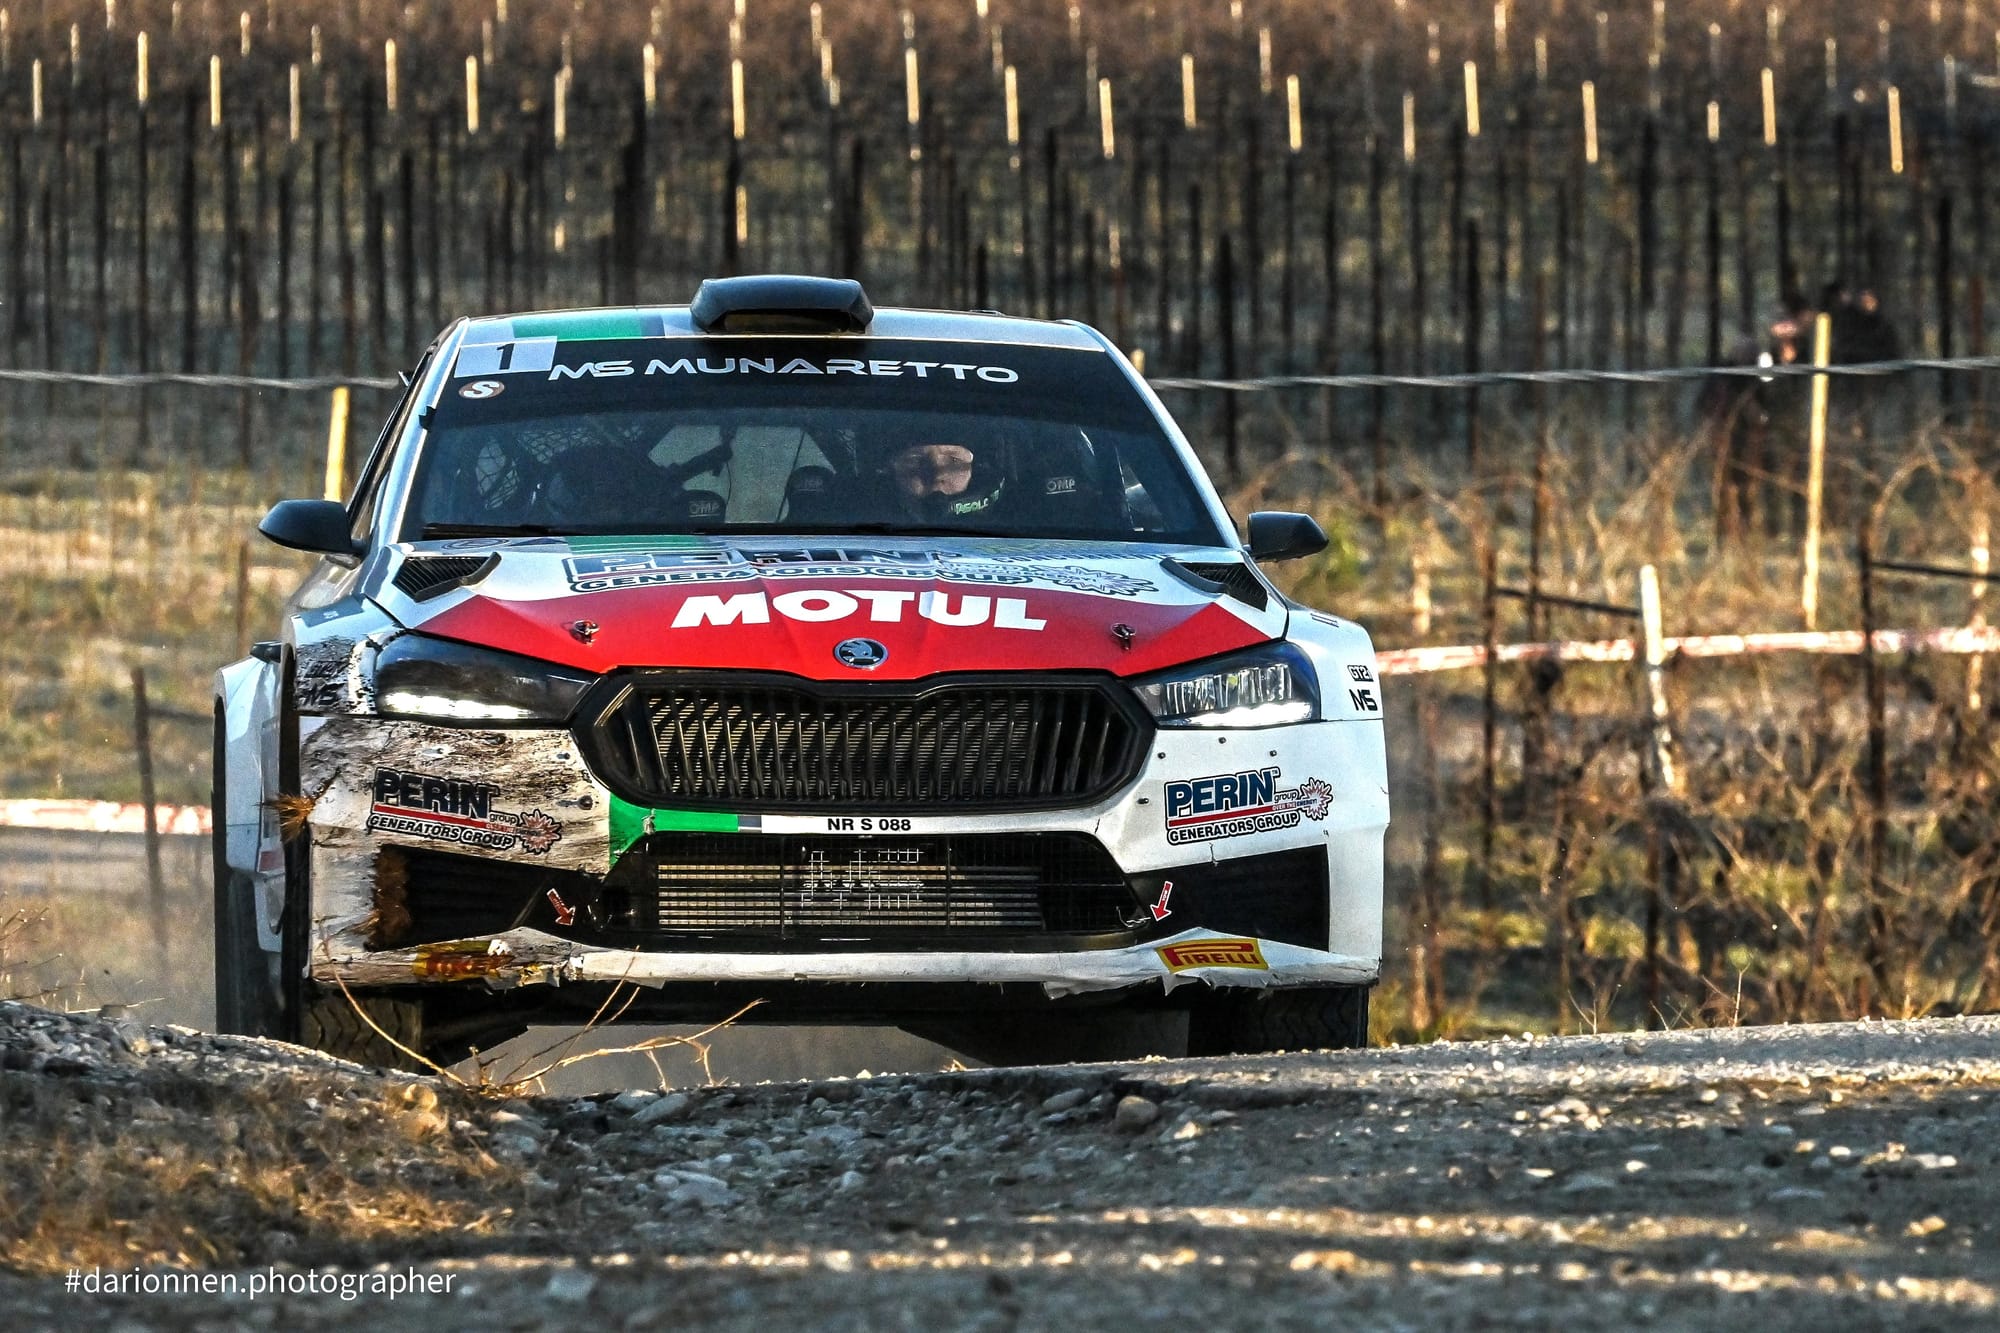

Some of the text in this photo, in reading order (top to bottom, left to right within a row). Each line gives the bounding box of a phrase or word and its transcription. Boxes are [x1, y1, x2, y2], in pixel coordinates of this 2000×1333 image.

[496, 343, 516, 370] 1
[548, 358, 1019, 383] MS MUNARETTO
[463, 380, 500, 399] S
[1047, 478, 1076, 491] OMP
[578, 567, 862, 590] GENERATORS
[872, 567, 1023, 582] GROUP
[670, 589, 1048, 631] MOTUL
[1349, 689, 1378, 711] MS
[375, 769, 490, 820] PERIN
[1167, 770, 1274, 817] PERIN
[1274, 791, 1298, 804] group
[369, 815, 513, 848] GENERATORS GROUP
[489, 813, 517, 826] group
[827, 817, 912, 831] NR S 088
[1169, 813, 1299, 842] GENERATORS GROUP
[1162, 943, 1260, 967] PIRELLI
